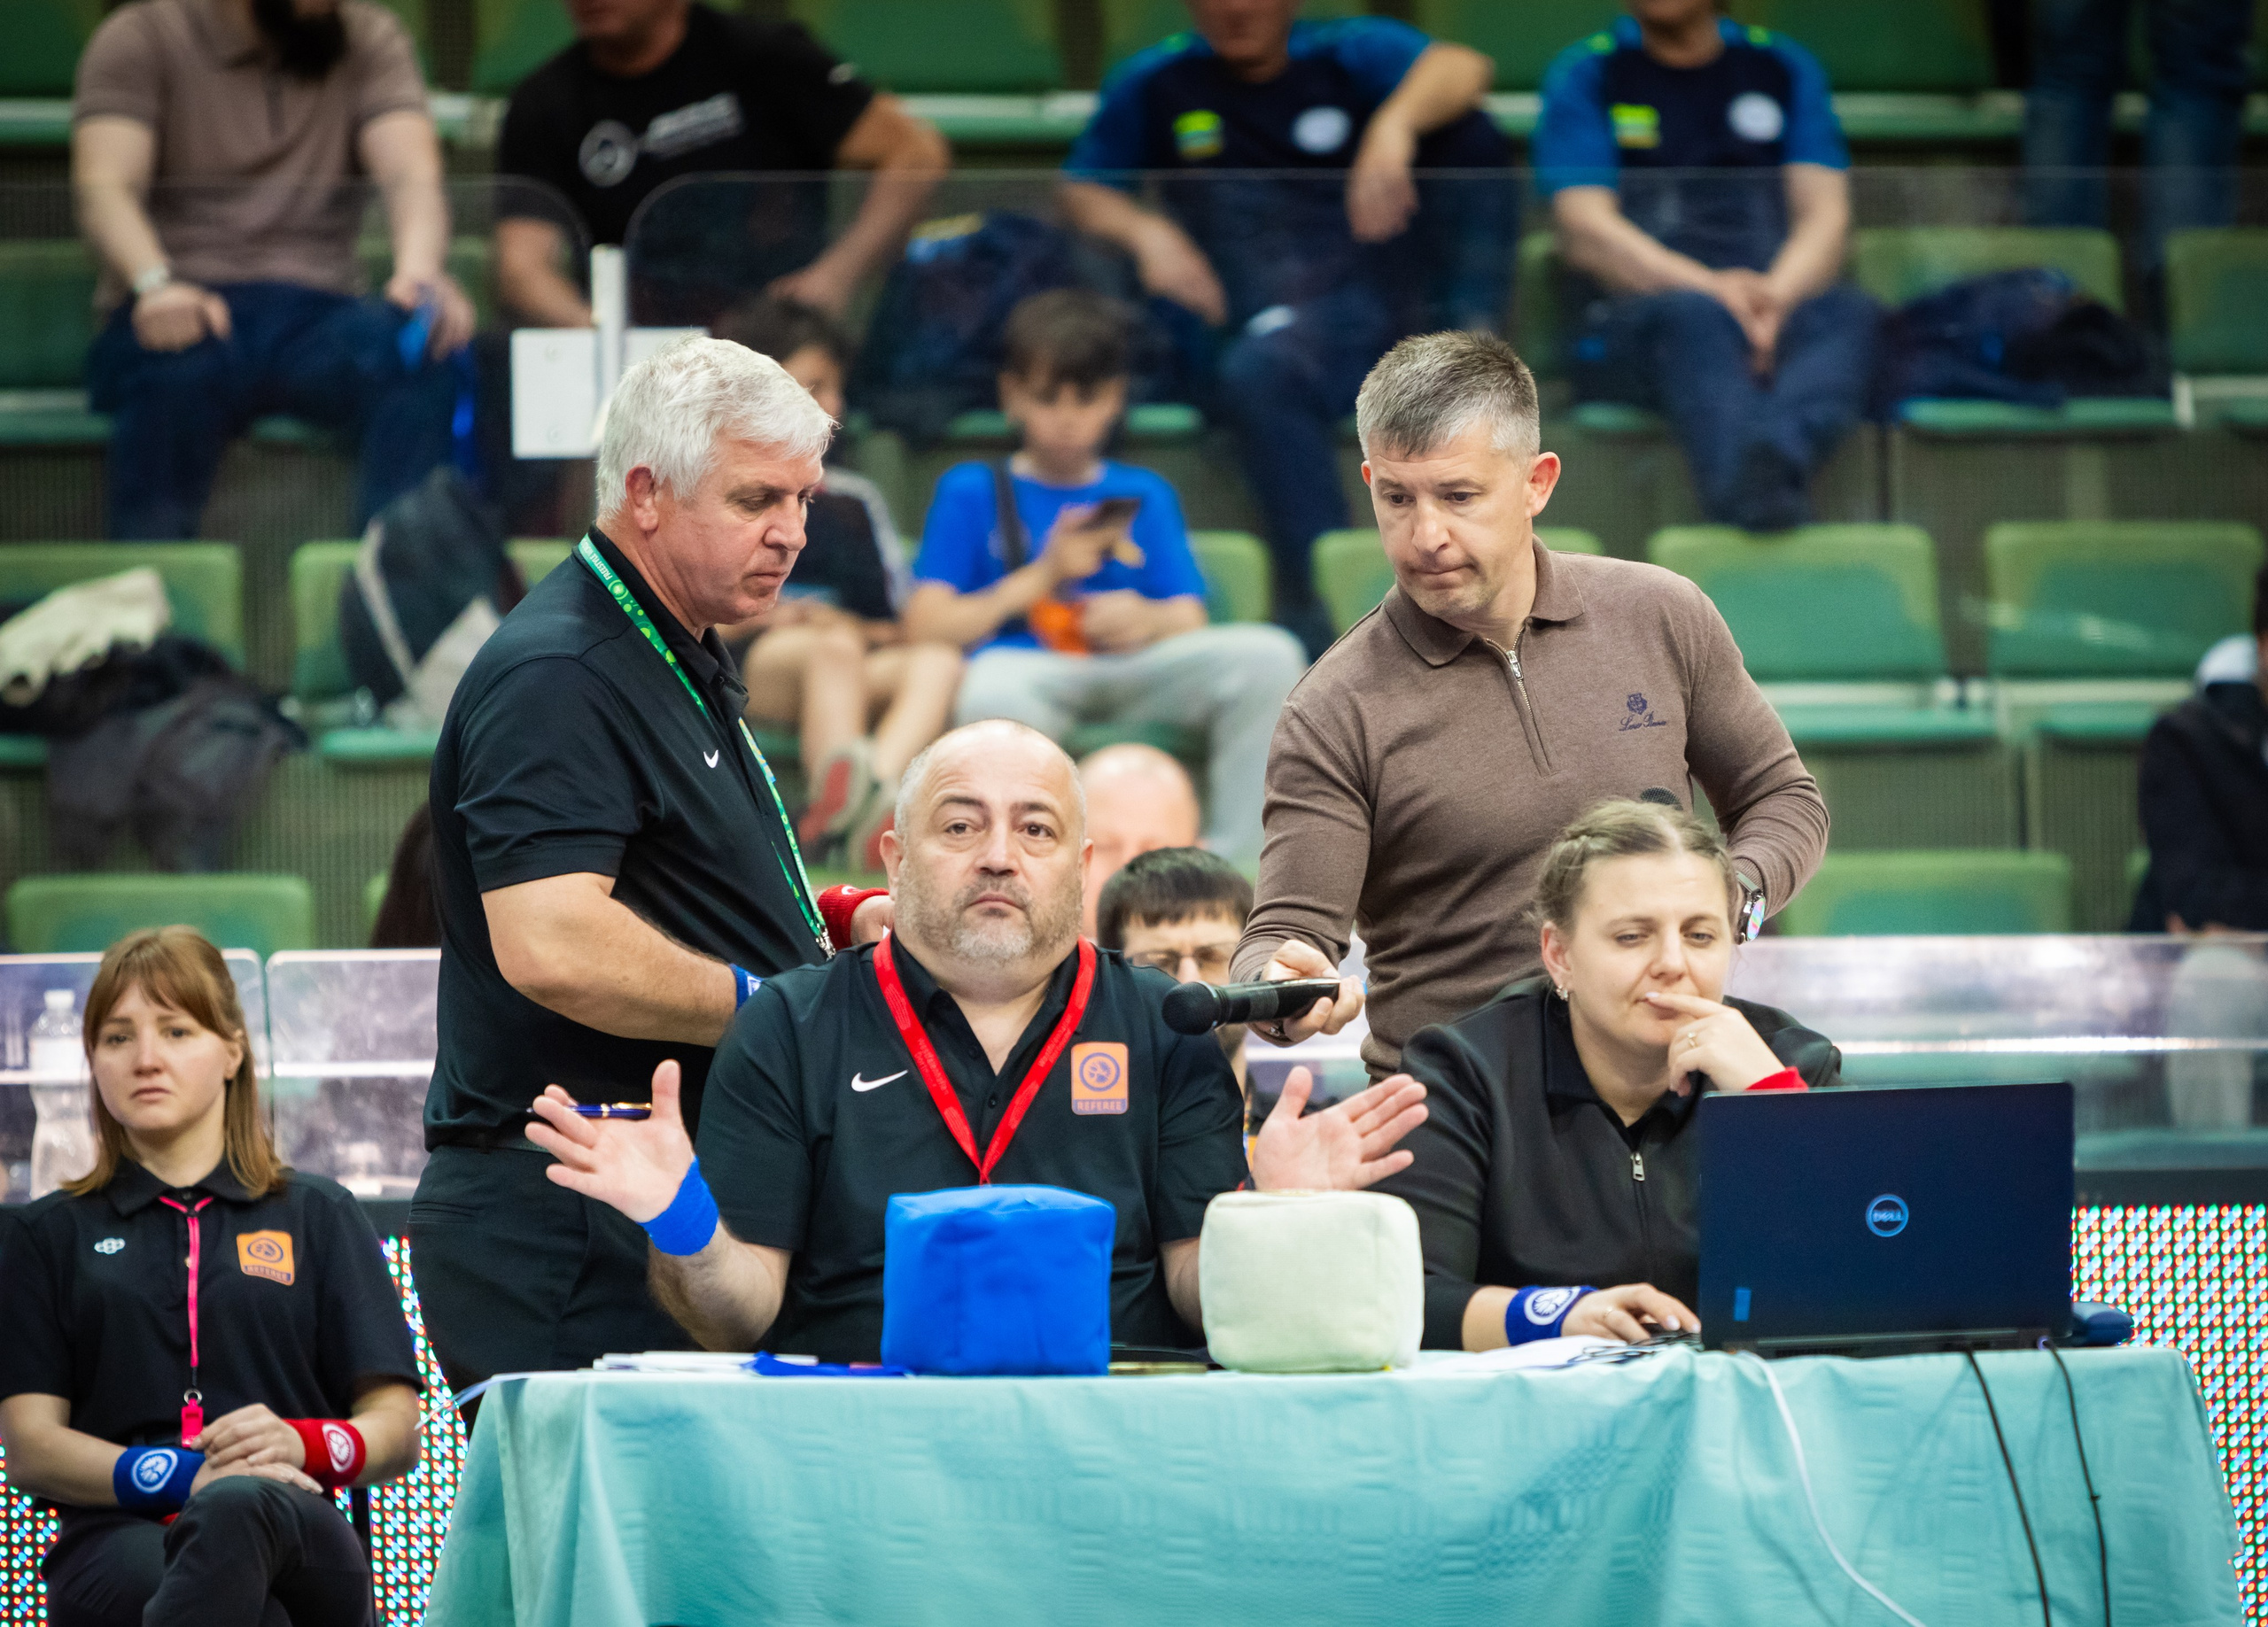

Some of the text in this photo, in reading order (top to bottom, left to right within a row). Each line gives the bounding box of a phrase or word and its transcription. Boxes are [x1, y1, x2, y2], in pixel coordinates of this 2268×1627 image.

[590, 553, 613, 581] FREESTYLE
[1076, 1100, 1122, 1112] REFEREE
[1872, 1209, 1904, 1222] DELL
